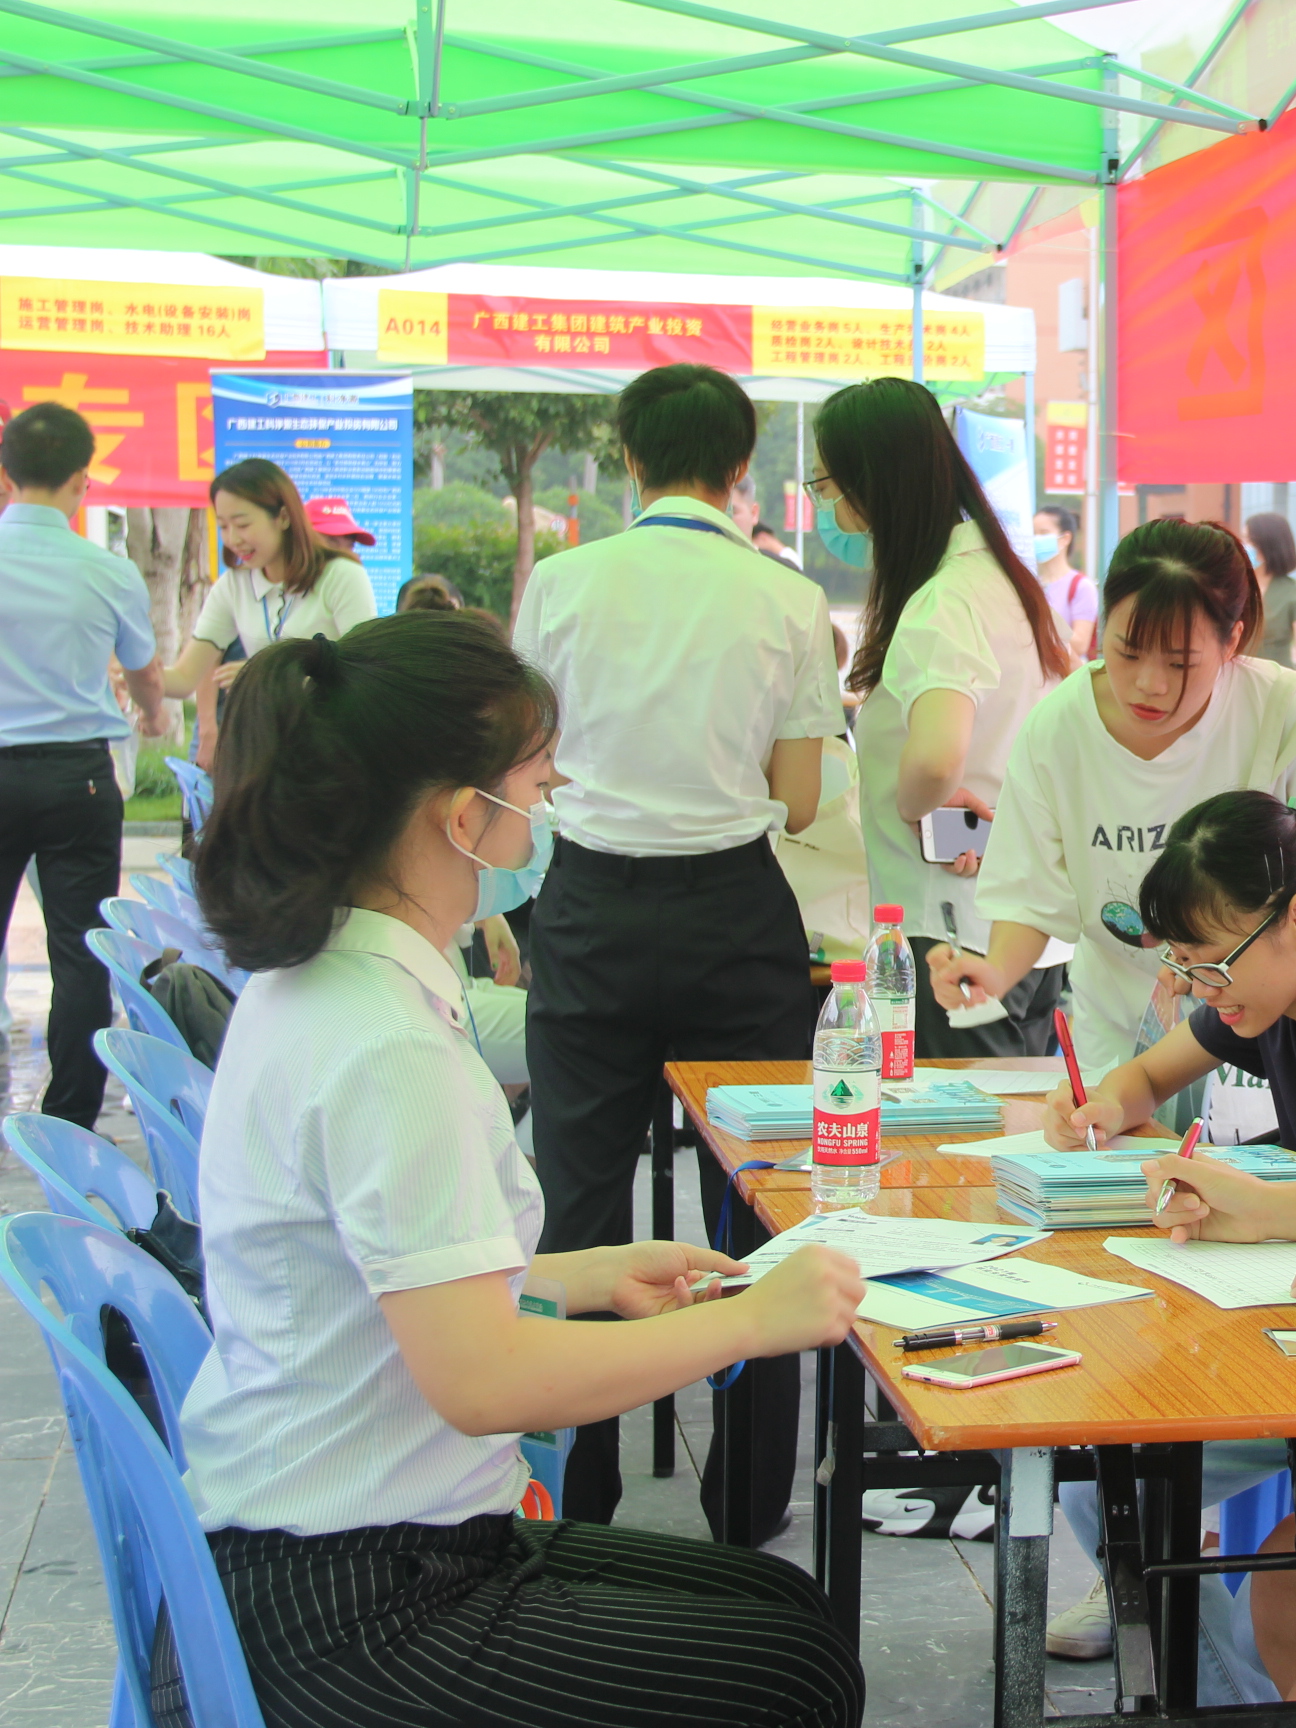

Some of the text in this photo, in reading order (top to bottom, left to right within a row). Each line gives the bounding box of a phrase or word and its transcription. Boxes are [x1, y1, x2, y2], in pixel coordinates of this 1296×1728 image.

[385, 317, 441, 337] A014
[473, 311, 703, 337] 广西建工集团建筑产业投资
[534, 334, 611, 355] 有限公司
[817, 1121, 868, 1138] 农夫山泉
[817, 1137, 869, 1147] NONGFU SPRING
